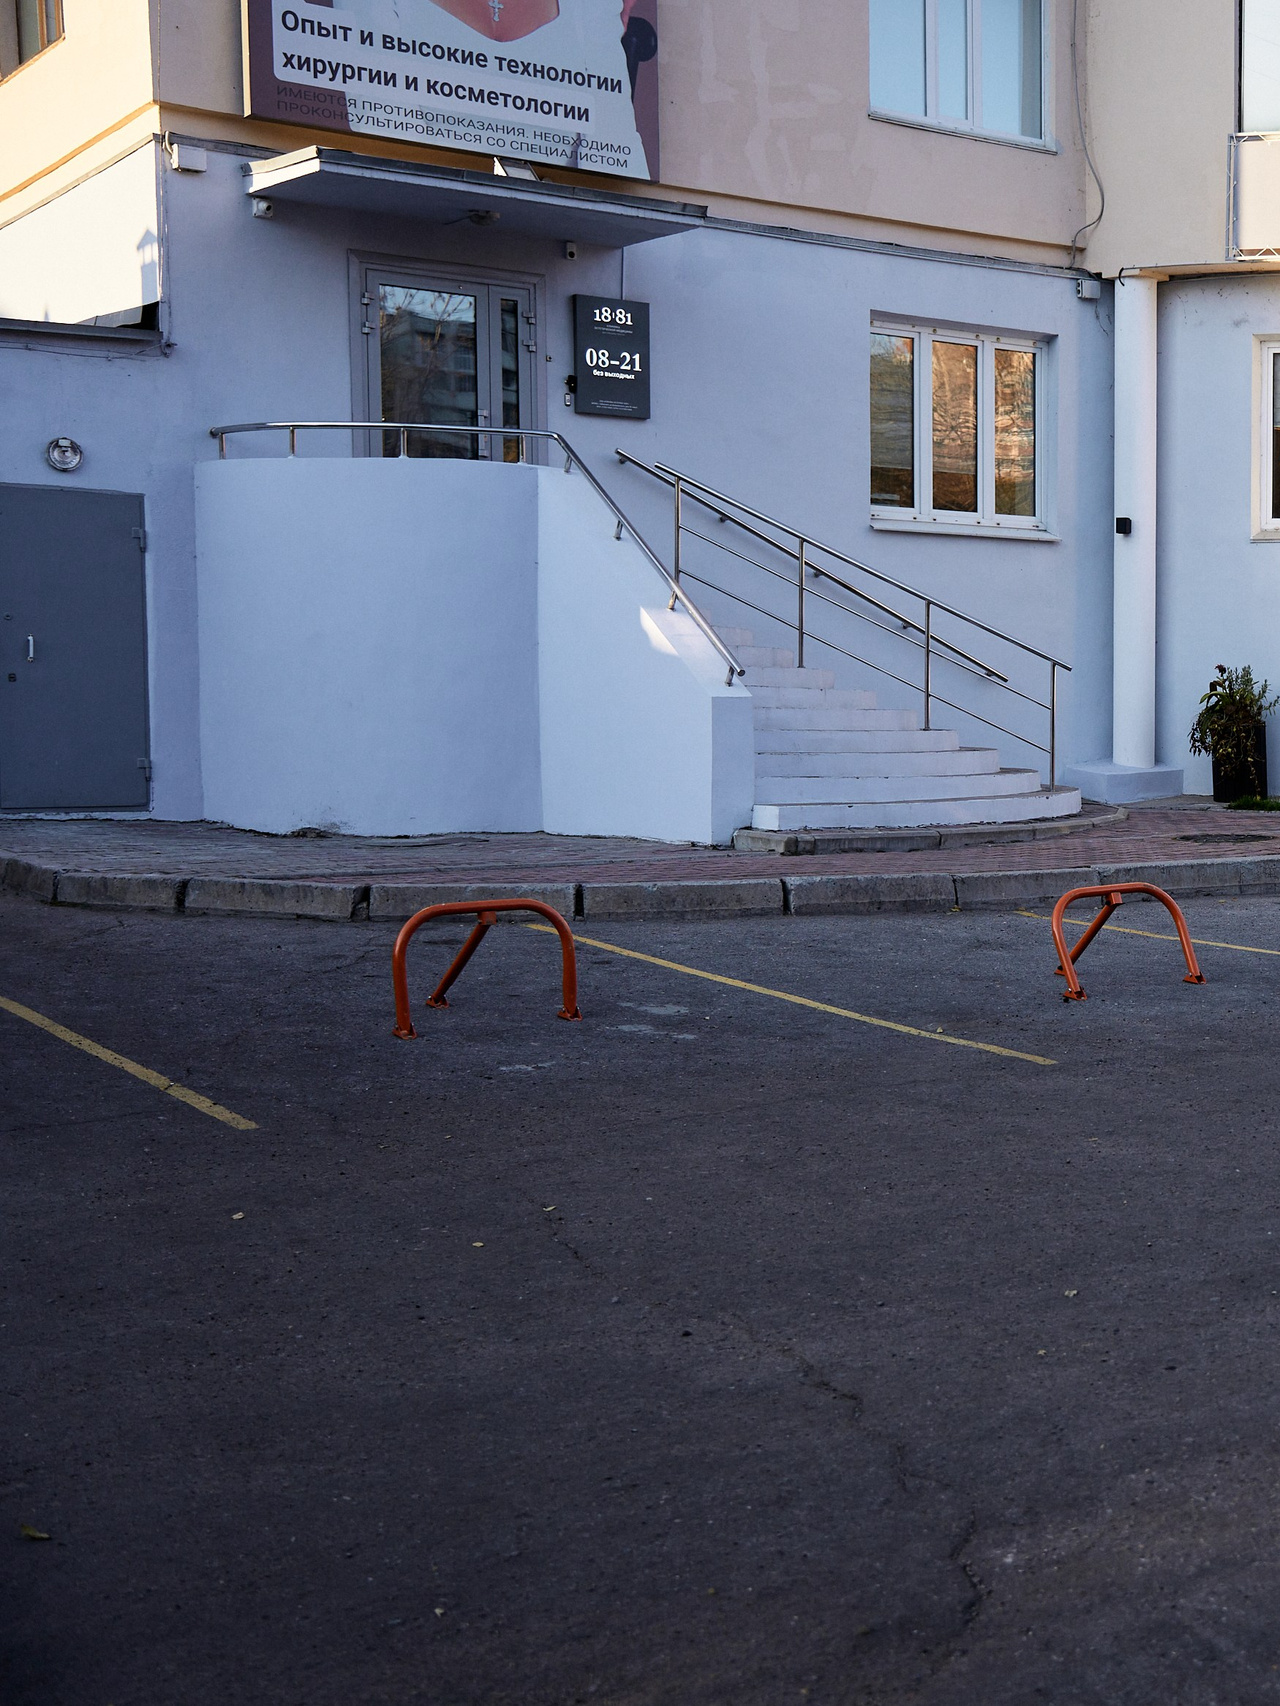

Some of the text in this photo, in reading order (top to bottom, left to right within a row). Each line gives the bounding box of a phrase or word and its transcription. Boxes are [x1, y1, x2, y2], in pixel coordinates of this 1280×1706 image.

[281, 10, 622, 94] Опыт и высокие технологии
[282, 52, 590, 122] хирургии и косметологии
[277, 85, 631, 155] ИМЕЮТСЯ ПРОТИВОПОКАЗАНИЯ. НЕОБХОДИМО
[277, 100, 628, 168] ПРОКОНСУЛЬТИРОВАТЬСЯ СО СПЕЦИАЛИСТОМ
[592, 369, 635, 380] без выходных
